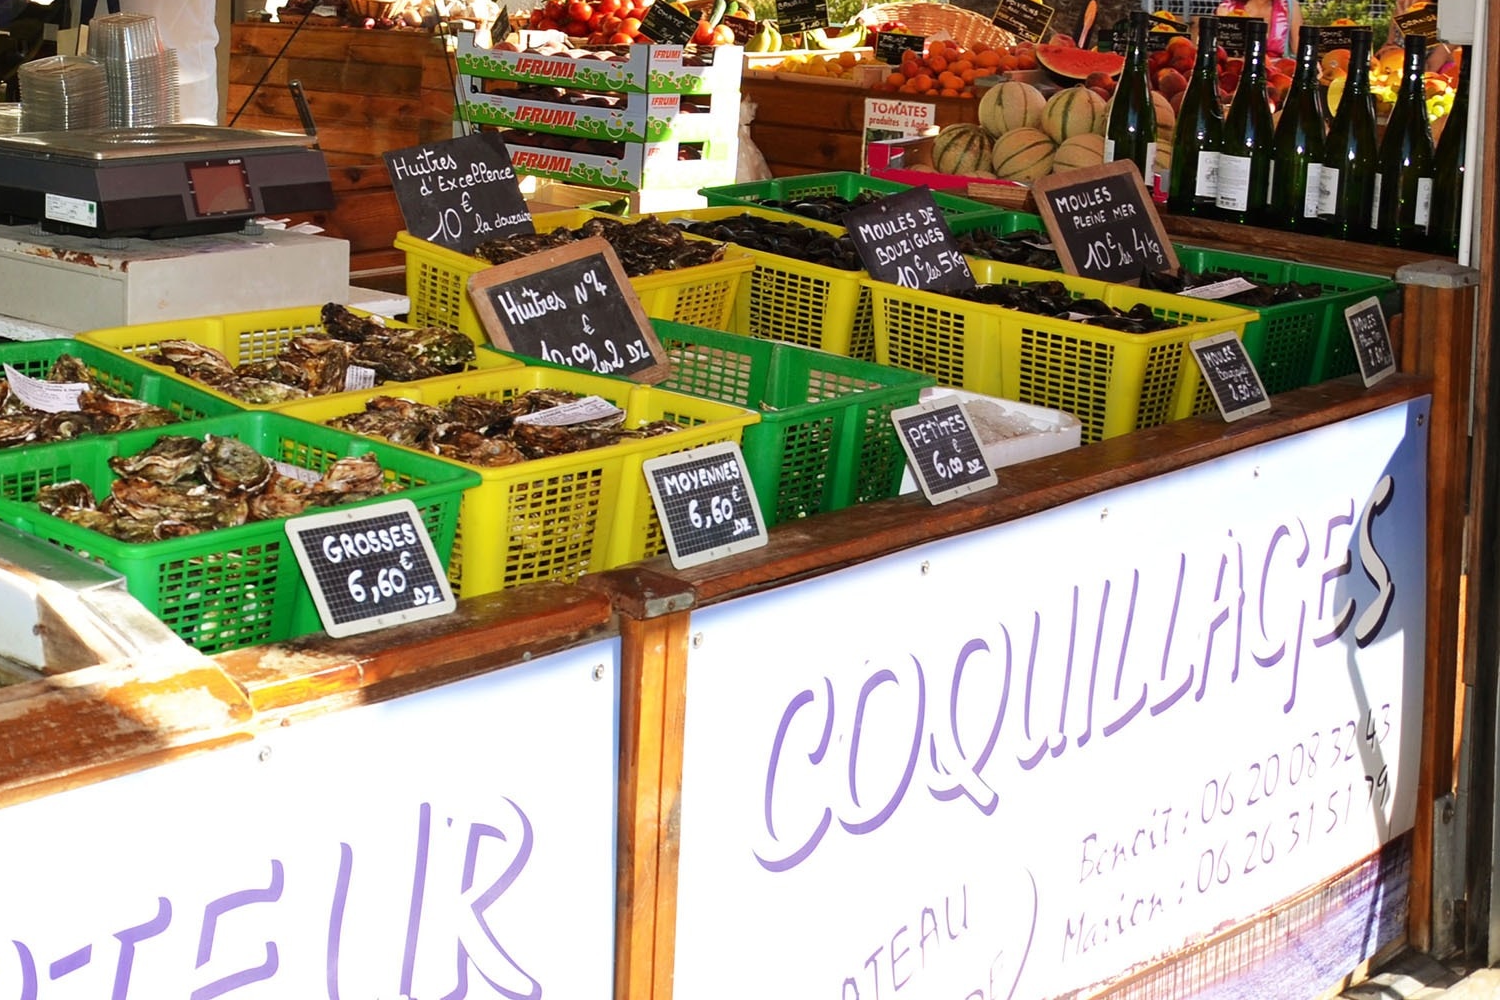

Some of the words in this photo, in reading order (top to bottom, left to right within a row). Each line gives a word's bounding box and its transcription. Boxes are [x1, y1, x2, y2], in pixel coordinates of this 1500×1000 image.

[653, 49, 681, 59] IFRUMI
[515, 57, 577, 81] IFRUMI
[651, 96, 679, 106] IFRUMI
[871, 102, 928, 118] TOMATES
[515, 105, 577, 129] IFRUMI
[868, 115, 900, 127] produites
[392, 147, 457, 181] Huîtres
[511, 149, 572, 174] IFRUMI
[1054, 186, 1112, 213] MOULES
[1112, 203, 1137, 219] MER
[473, 213, 493, 233] la
[858, 212, 917, 244] MOULES
[918, 206, 937, 226] DE
[498, 286, 567, 326] Huîtres
[626, 339, 650, 364] DZ
[1203, 344, 1237, 368] MOULES
[663, 460, 740, 496] MOYENNES
[322, 523, 417, 564] GROSSES
[413, 585, 441, 606] DZ
[752, 473, 1396, 873] COQUILLAGES
[1201, 771, 1234, 824] 06
[1246, 753, 1280, 806] 20
[1288, 732, 1320, 786] 08
[1330, 720, 1356, 769] 32
[1366, 703, 1391, 751] 43
[1197, 840, 1231, 894] 06
[1243, 823, 1275, 875] 26
[1288, 801, 1315, 854] 31
[1326, 783, 1352, 835] 51
[1364, 763, 1391, 809] 79
